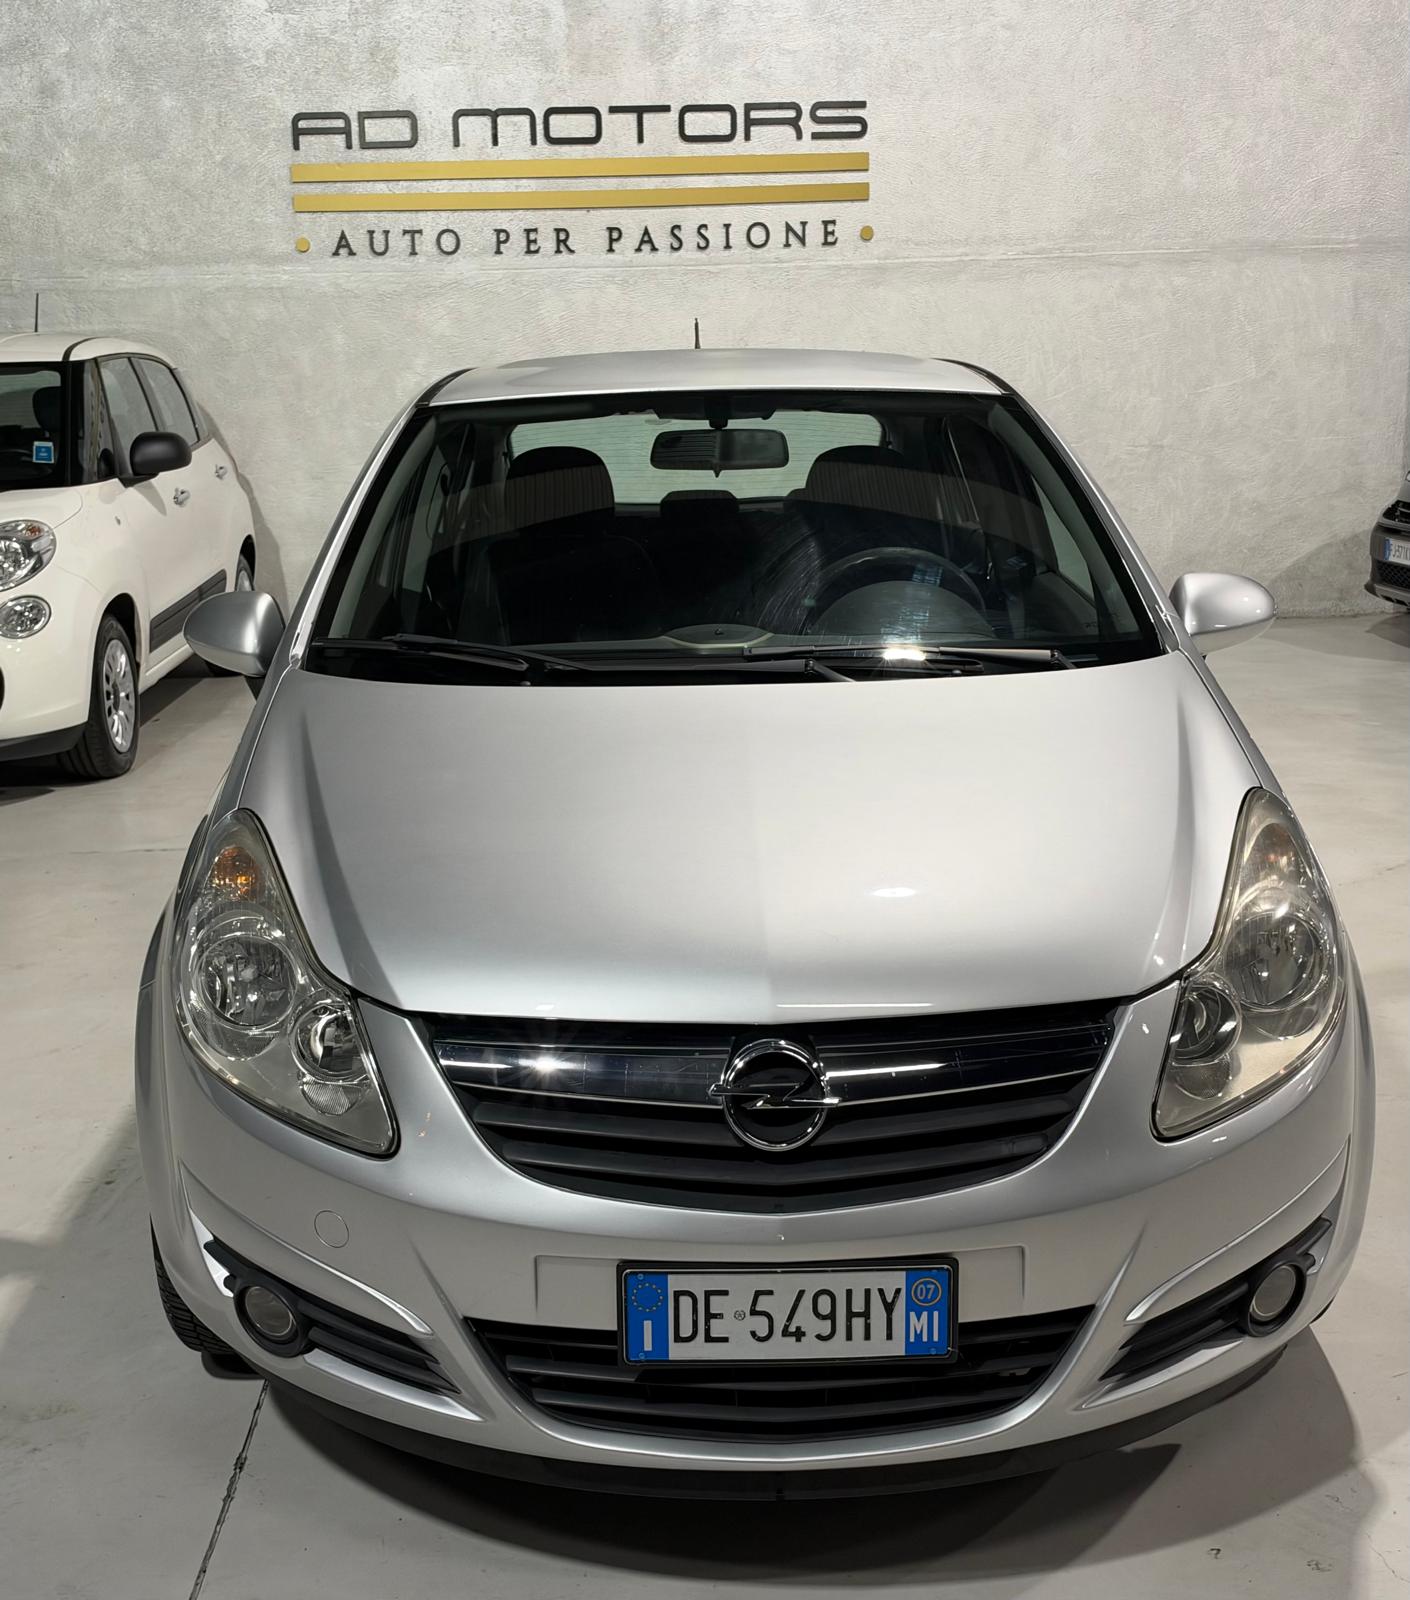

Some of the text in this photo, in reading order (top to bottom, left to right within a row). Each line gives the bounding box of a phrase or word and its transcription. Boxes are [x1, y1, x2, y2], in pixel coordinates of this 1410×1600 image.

[292, 101, 867, 150] AD MOTORS
[332, 219, 838, 256] AUTO PER PASSIONE
[917, 1283, 935, 1300] 07
[909, 1310, 939, 1342] MI
